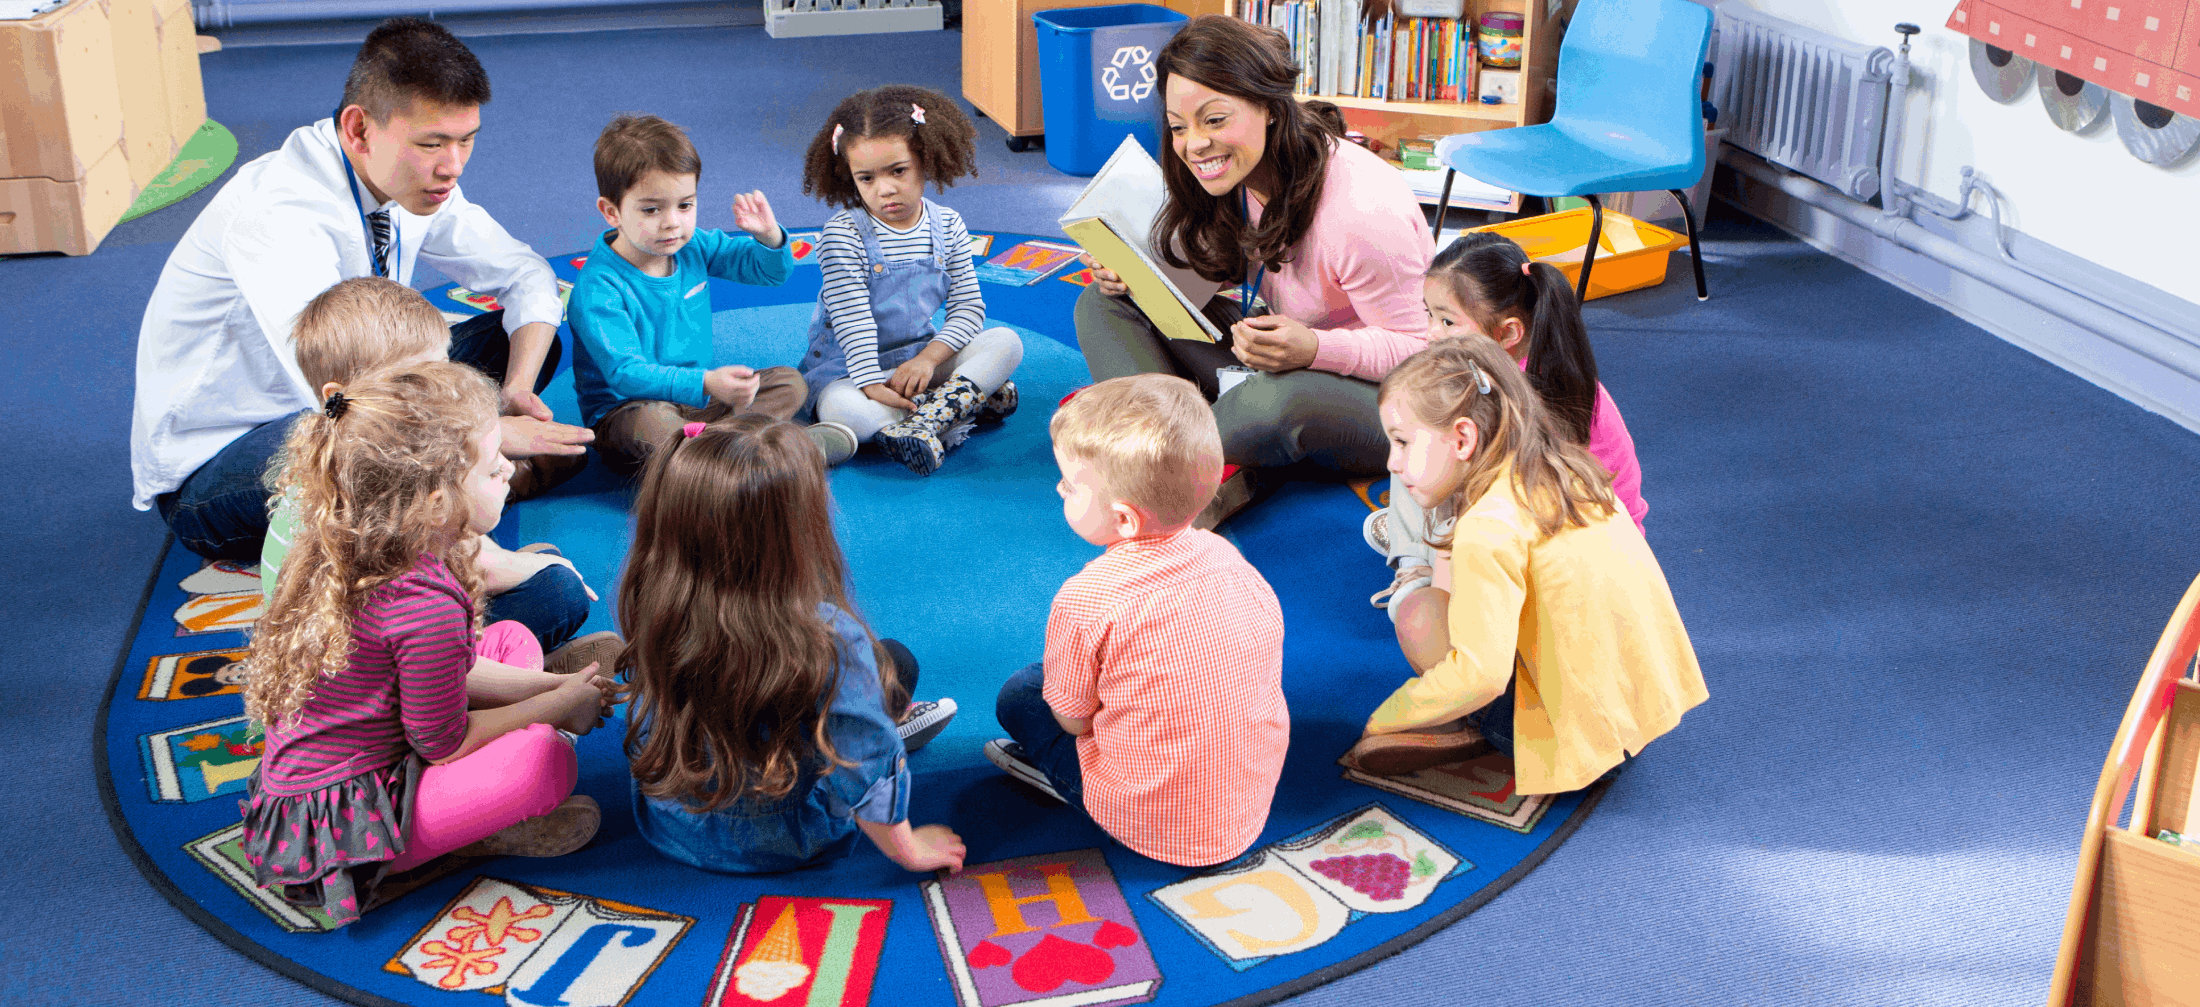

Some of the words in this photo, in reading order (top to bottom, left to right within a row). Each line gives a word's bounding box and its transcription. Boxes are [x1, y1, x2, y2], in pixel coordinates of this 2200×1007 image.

[1003, 245, 1077, 270] W
[965, 860, 1104, 939] H
[1181, 870, 1320, 954] G
[511, 923, 656, 1007] J
